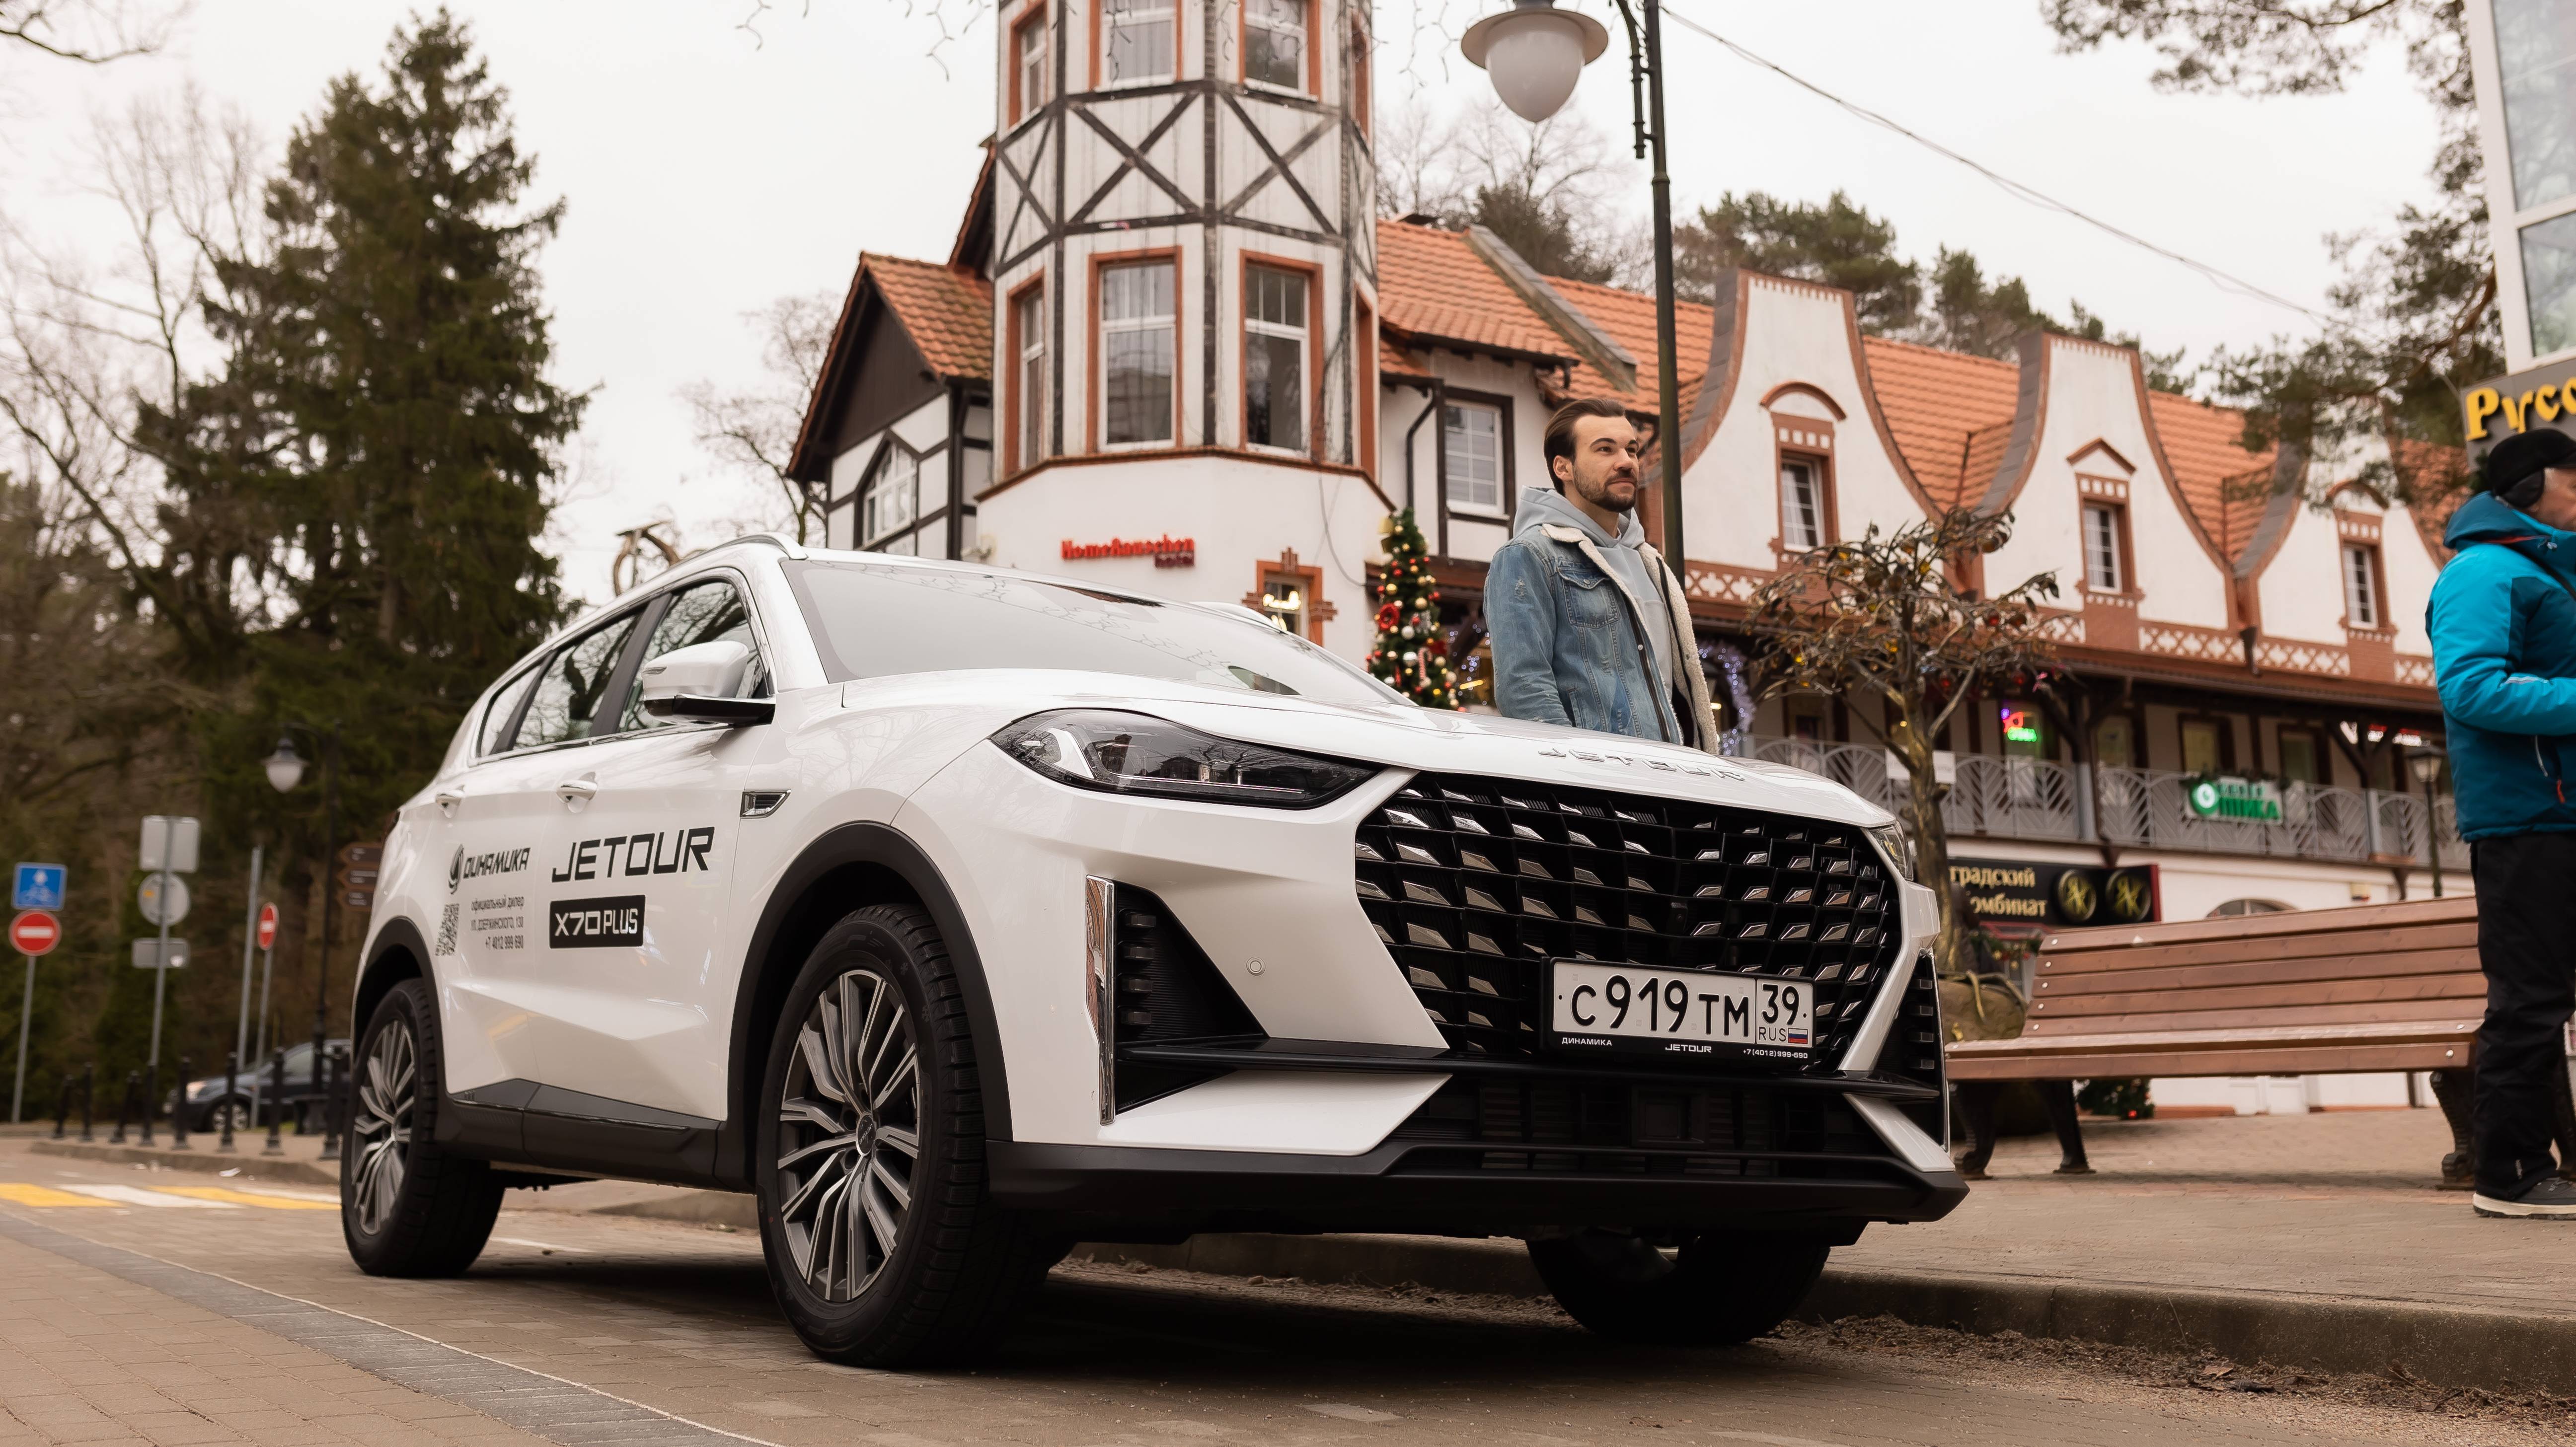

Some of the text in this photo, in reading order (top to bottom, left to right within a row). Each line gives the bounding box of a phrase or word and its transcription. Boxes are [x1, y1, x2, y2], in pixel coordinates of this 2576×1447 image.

[1538, 747, 1745, 782] JETOUR
[551, 826, 715, 883] JETOUR
[1966, 891, 2047, 917] омбинат
[1761, 984, 1800, 1025] 39
[1562, 1037, 1612, 1046] ДИНАМИКА
[1758, 1026, 1786, 1042] RUS
[1665, 1044, 1712, 1053] JETOUR
